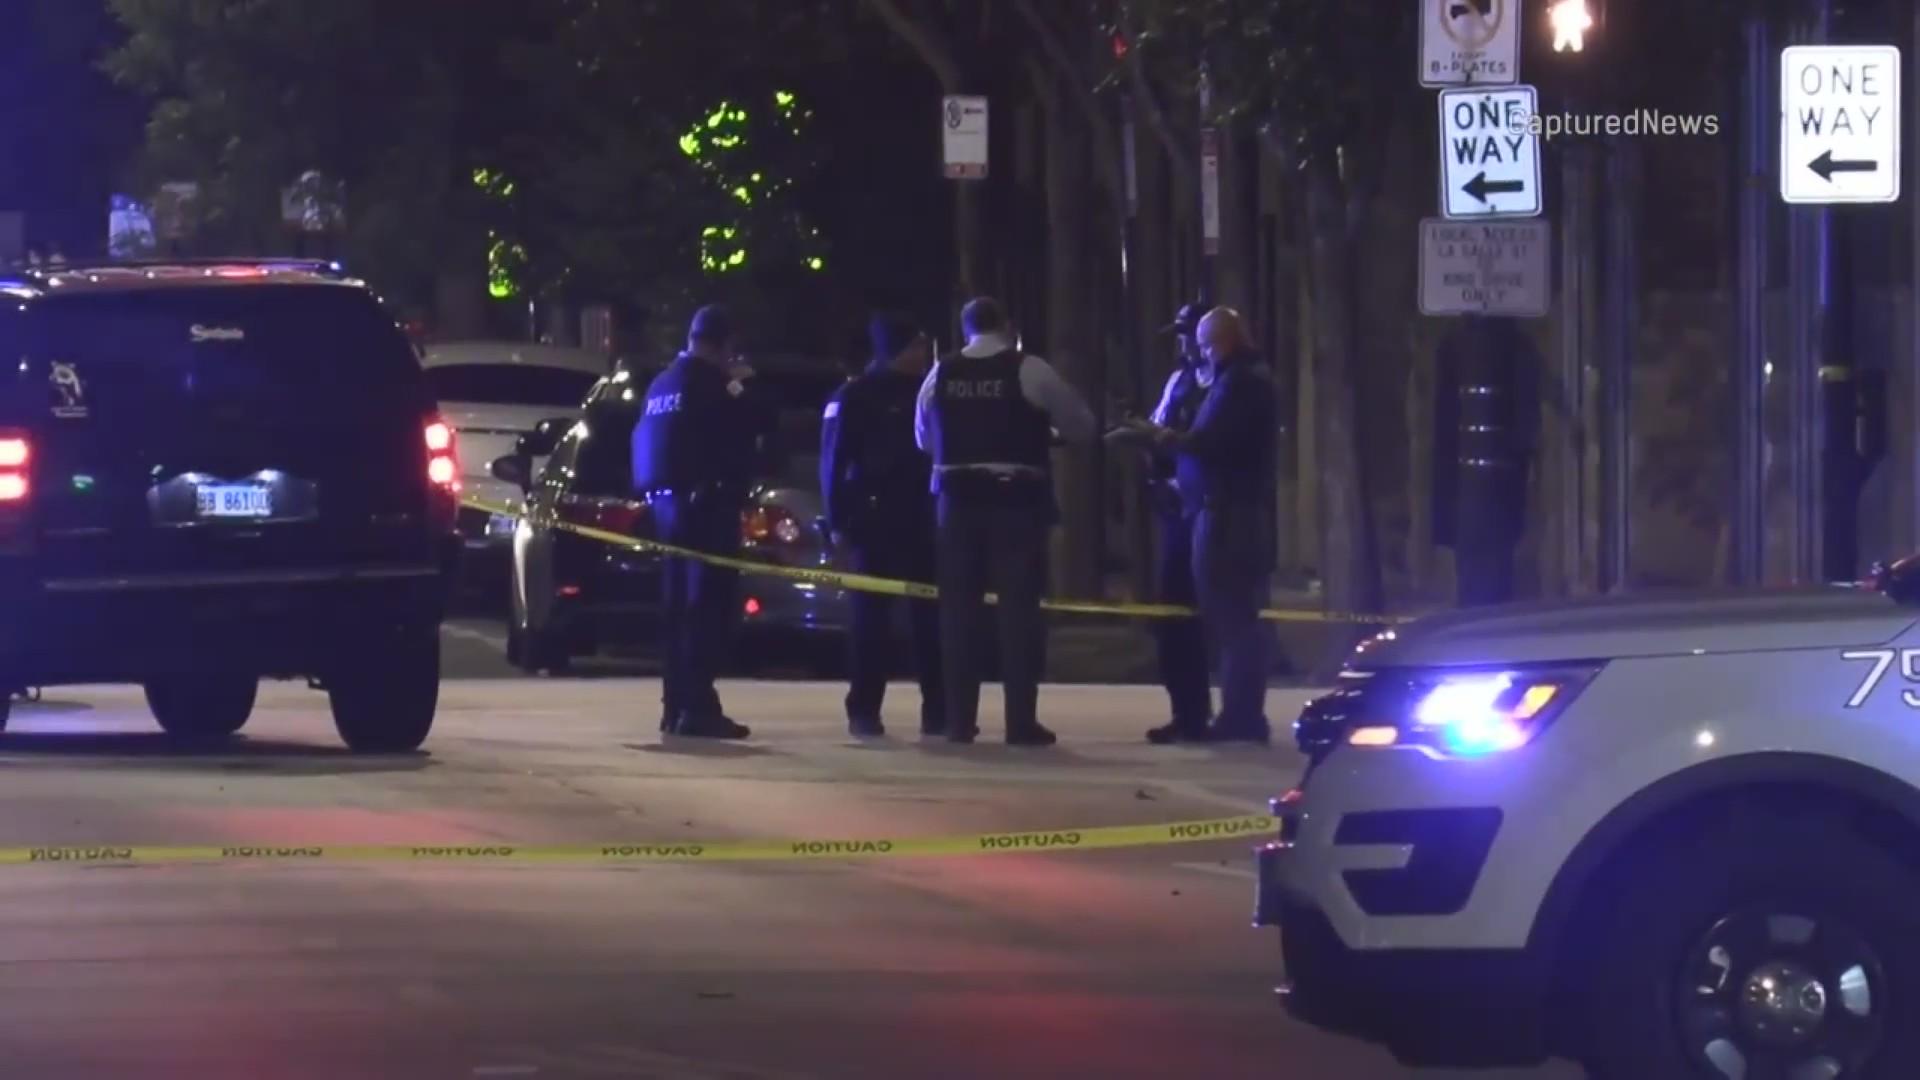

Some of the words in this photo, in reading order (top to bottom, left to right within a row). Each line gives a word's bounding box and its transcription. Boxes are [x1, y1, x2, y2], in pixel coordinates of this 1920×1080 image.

[1800, 63, 1880, 95] ONE
[1455, 100, 1521, 130] ONE
[1798, 106, 1881, 136] WAY
[1453, 136, 1525, 164] WAY
[946, 379, 1003, 398] POLICE
[645, 392, 684, 416] POLICE
